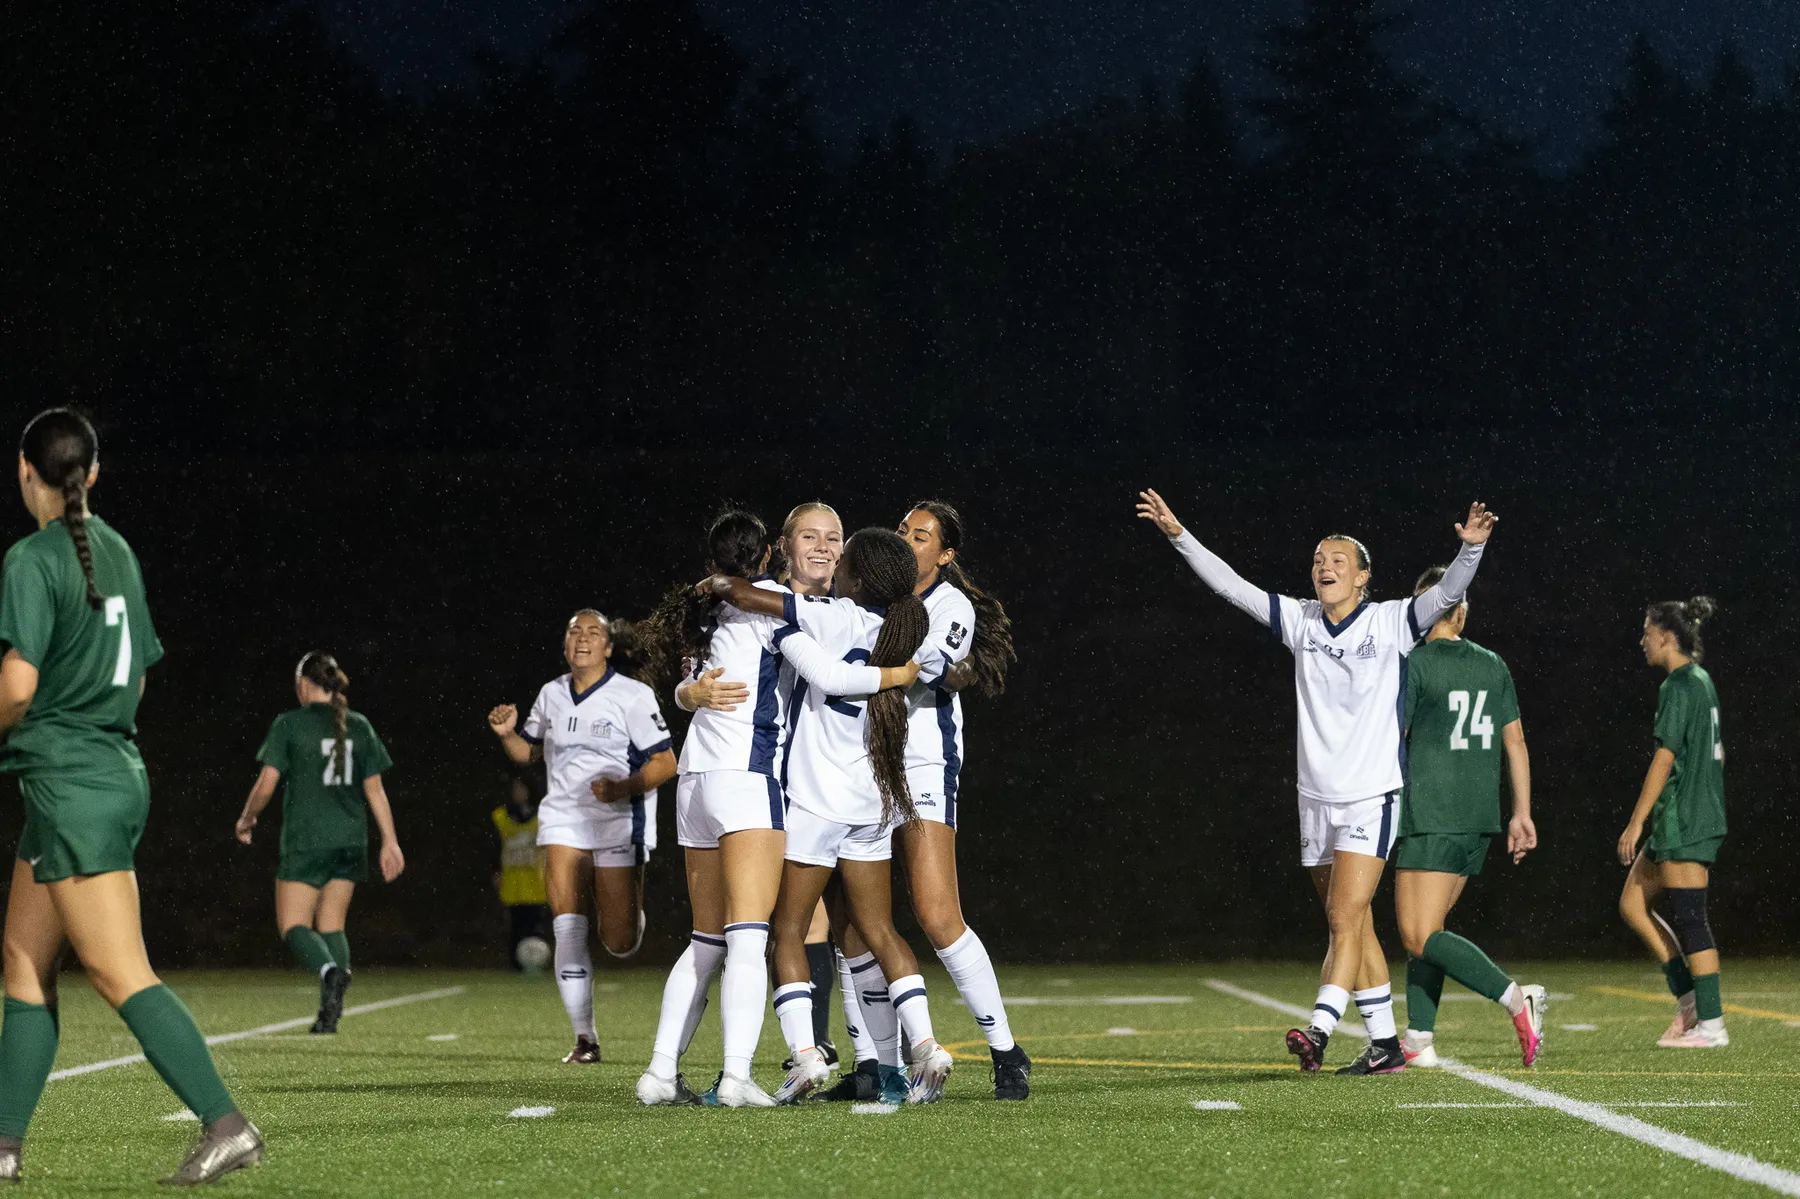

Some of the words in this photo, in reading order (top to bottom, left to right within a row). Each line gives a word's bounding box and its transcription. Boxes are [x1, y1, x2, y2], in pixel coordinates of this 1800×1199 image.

[105, 595, 132, 687] 7
[567, 716, 578, 732] 11
[1448, 690, 1495, 750] 24
[321, 738, 353, 786] 21
